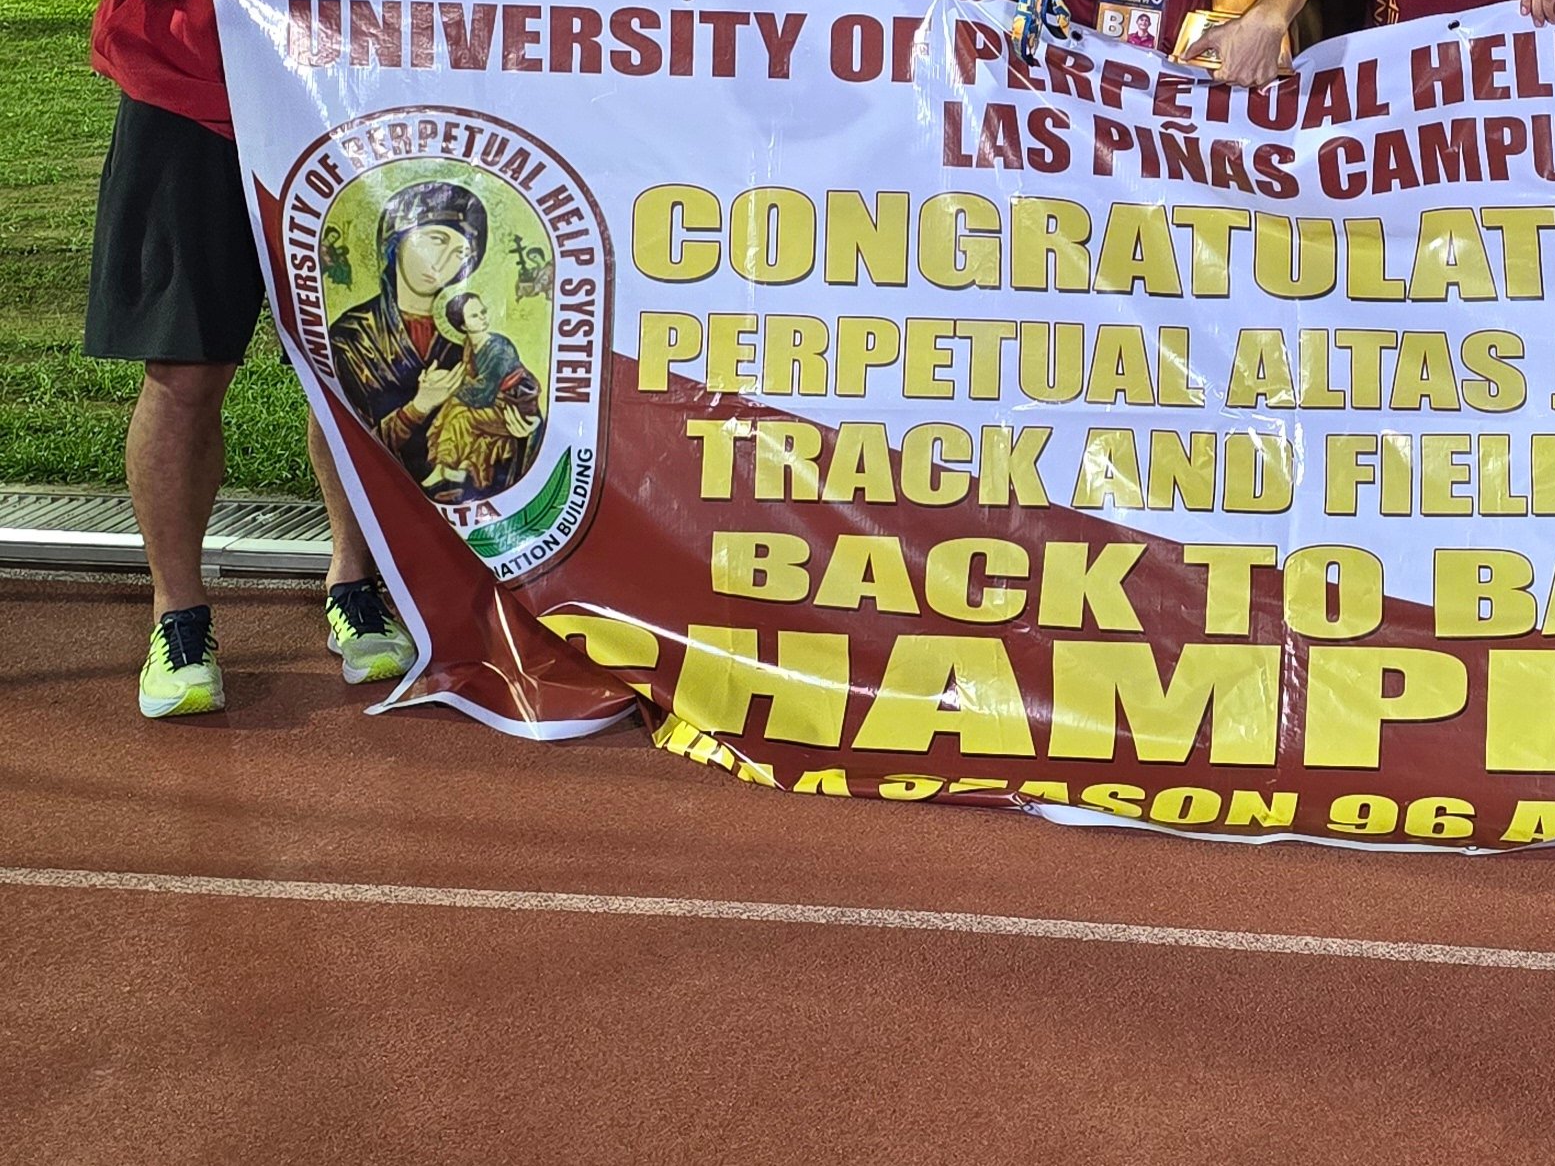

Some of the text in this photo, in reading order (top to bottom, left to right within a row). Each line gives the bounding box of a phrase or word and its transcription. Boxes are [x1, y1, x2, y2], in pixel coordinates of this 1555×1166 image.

[830, 14, 932, 83] OF
[954, 18, 1390, 130] PERPETUAL
[1102, 10, 1124, 38] B
[943, 101, 1071, 173] LAS
[1093, 118, 1300, 200] PIÑAS
[288, 119, 598, 404] UNIVERSITY OF PERPETUAL HELP SYSTEM
[638, 311, 1204, 407] PERPETUAL
[1226, 328, 1528, 411] ALTAS
[557, 447, 593, 538] BUILDING
[687, 420, 1053, 506] TRACK
[1071, 427, 1295, 513] AND
[711, 530, 1148, 632] BACK
[1184, 544, 1386, 639] TO
[1328, 793, 1475, 838] 96
